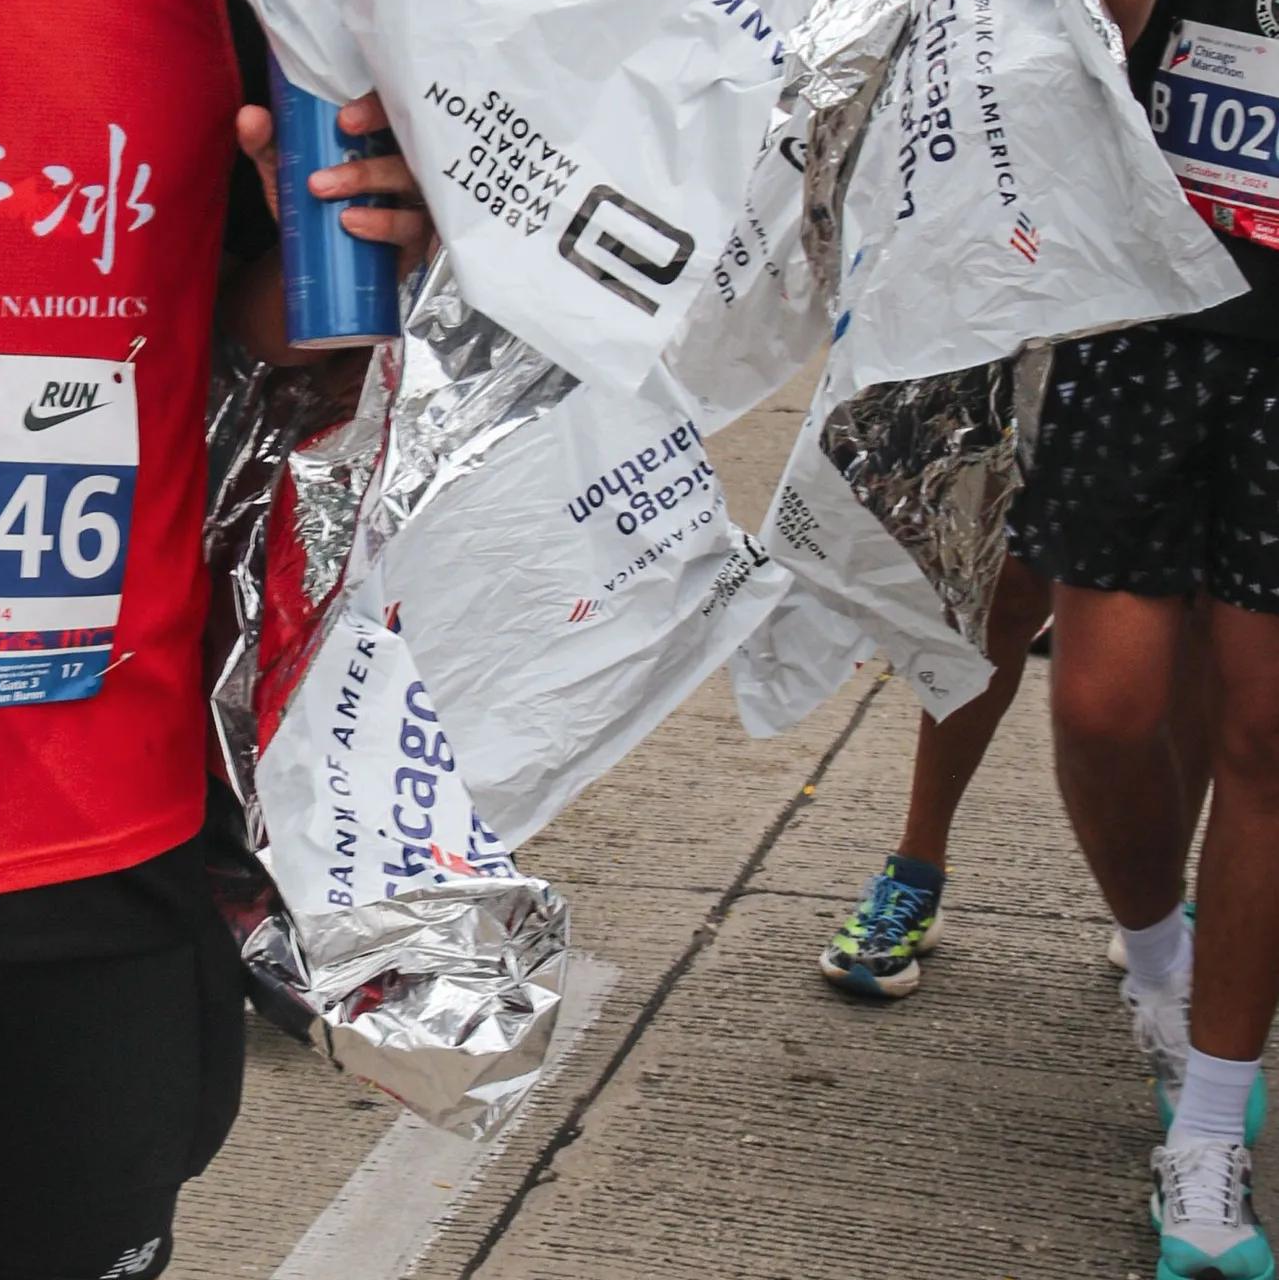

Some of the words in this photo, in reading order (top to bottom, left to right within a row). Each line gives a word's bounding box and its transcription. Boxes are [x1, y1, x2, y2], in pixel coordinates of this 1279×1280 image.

[424, 80, 568, 198] MARATHON
[482, 90, 581, 179] MAJORS
[977, 84, 1017, 207] AMERICA
[1151, 81, 1172, 134] B
[1188, 92, 1279, 161] 102
[442, 159, 543, 237] ABBOTT
[469, 145, 553, 222] WORLD
[40, 381, 100, 408] RUN
[604, 530, 685, 593] AMERICA
[61, 662, 84, 679] 17
[333, 637, 377, 751] AMER
